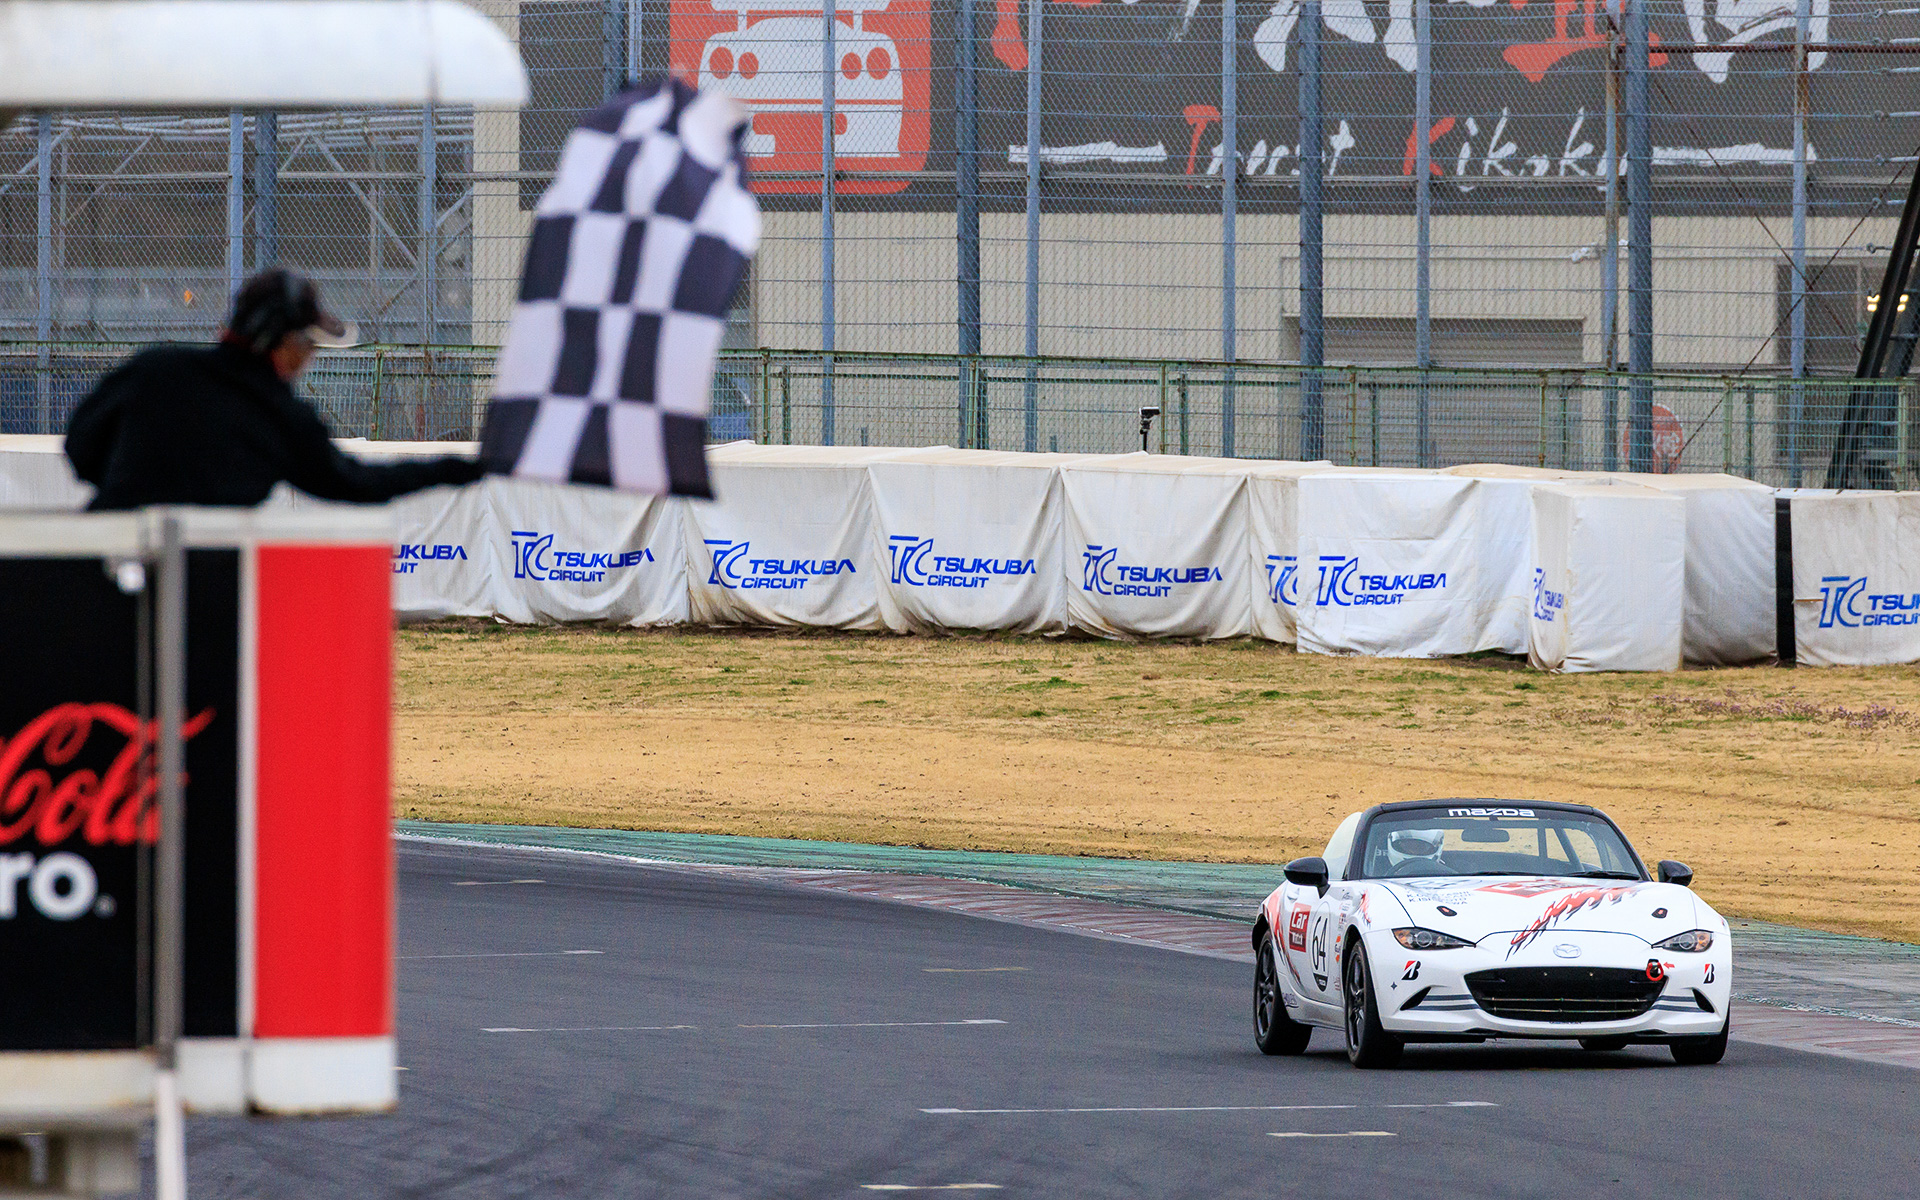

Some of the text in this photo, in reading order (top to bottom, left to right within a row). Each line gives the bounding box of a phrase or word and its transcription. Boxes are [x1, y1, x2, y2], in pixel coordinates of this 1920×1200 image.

[553, 548, 655, 569] TSUKUBA
[749, 558, 857, 576] TSUKUBA
[934, 556, 1037, 575] TSUKUBA
[1117, 565, 1223, 583] TSUKUBA
[1359, 573, 1447, 591] TSUKUBA
[1448, 808, 1536, 817] mazda
[1291, 907, 1308, 930] Car
[1312, 916, 1328, 972] 64
